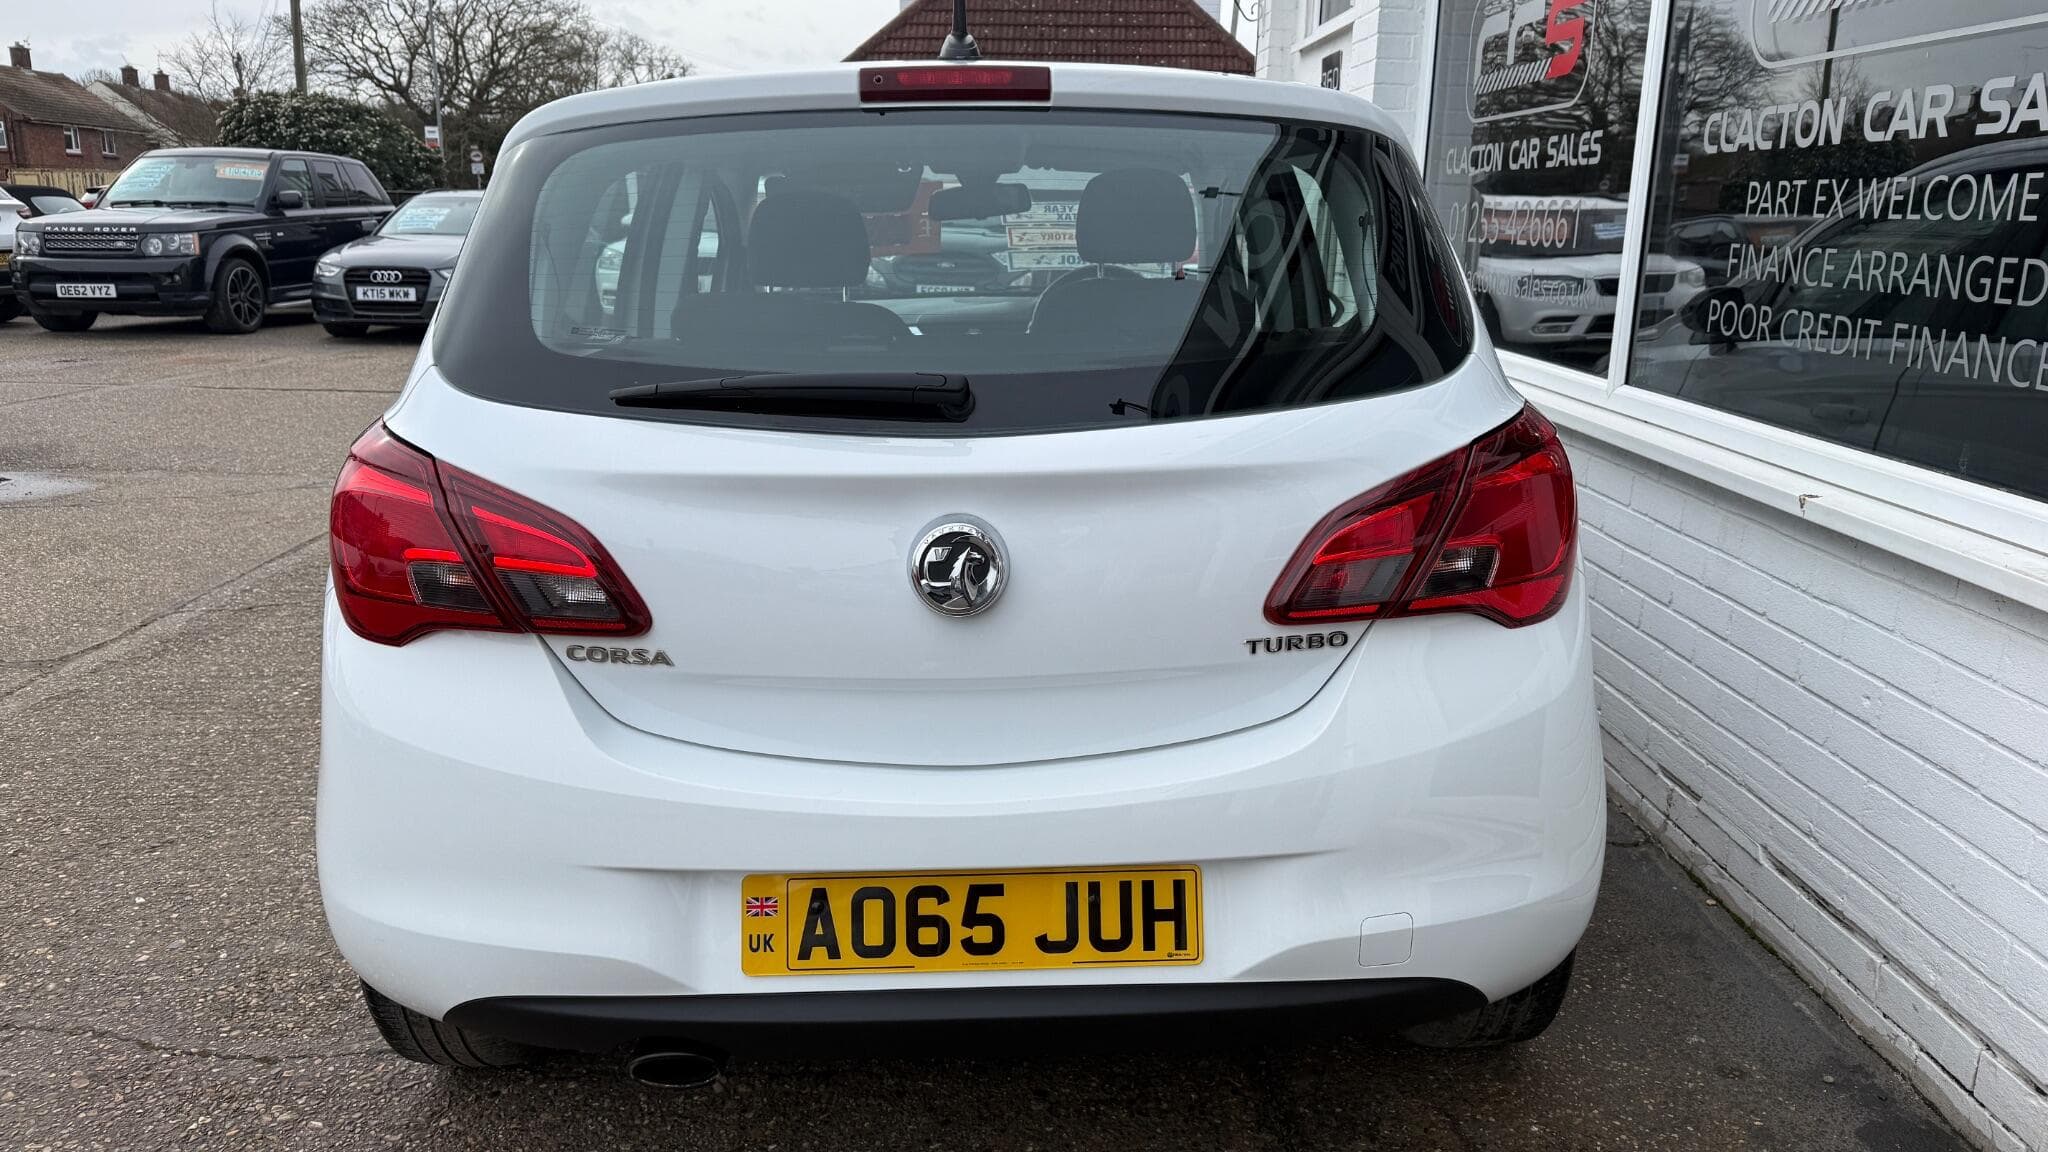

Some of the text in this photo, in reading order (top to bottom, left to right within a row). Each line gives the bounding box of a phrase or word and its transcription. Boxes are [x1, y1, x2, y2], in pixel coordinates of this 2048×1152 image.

[1703, 97, 1847, 155] CLACTON
[1863, 83, 1955, 142] CAR
[1446, 129, 1604, 176] CLACTON CAR SALES
[1745, 172, 2045, 222] PART EX WELCOME
[60, 286, 111, 296] OE62 VYZ
[362, 289, 410, 299] KT15 WKW
[1727, 243, 2048, 308] FINANCE ARRANGED
[1706, 299, 2048, 393] POOR CREDIT FINANCE
[566, 644, 675, 667] CORSA
[1244, 631, 1349, 655] TURBO
[748, 932, 775, 953] UK
[796, 879, 1188, 960] AO65 JUH
